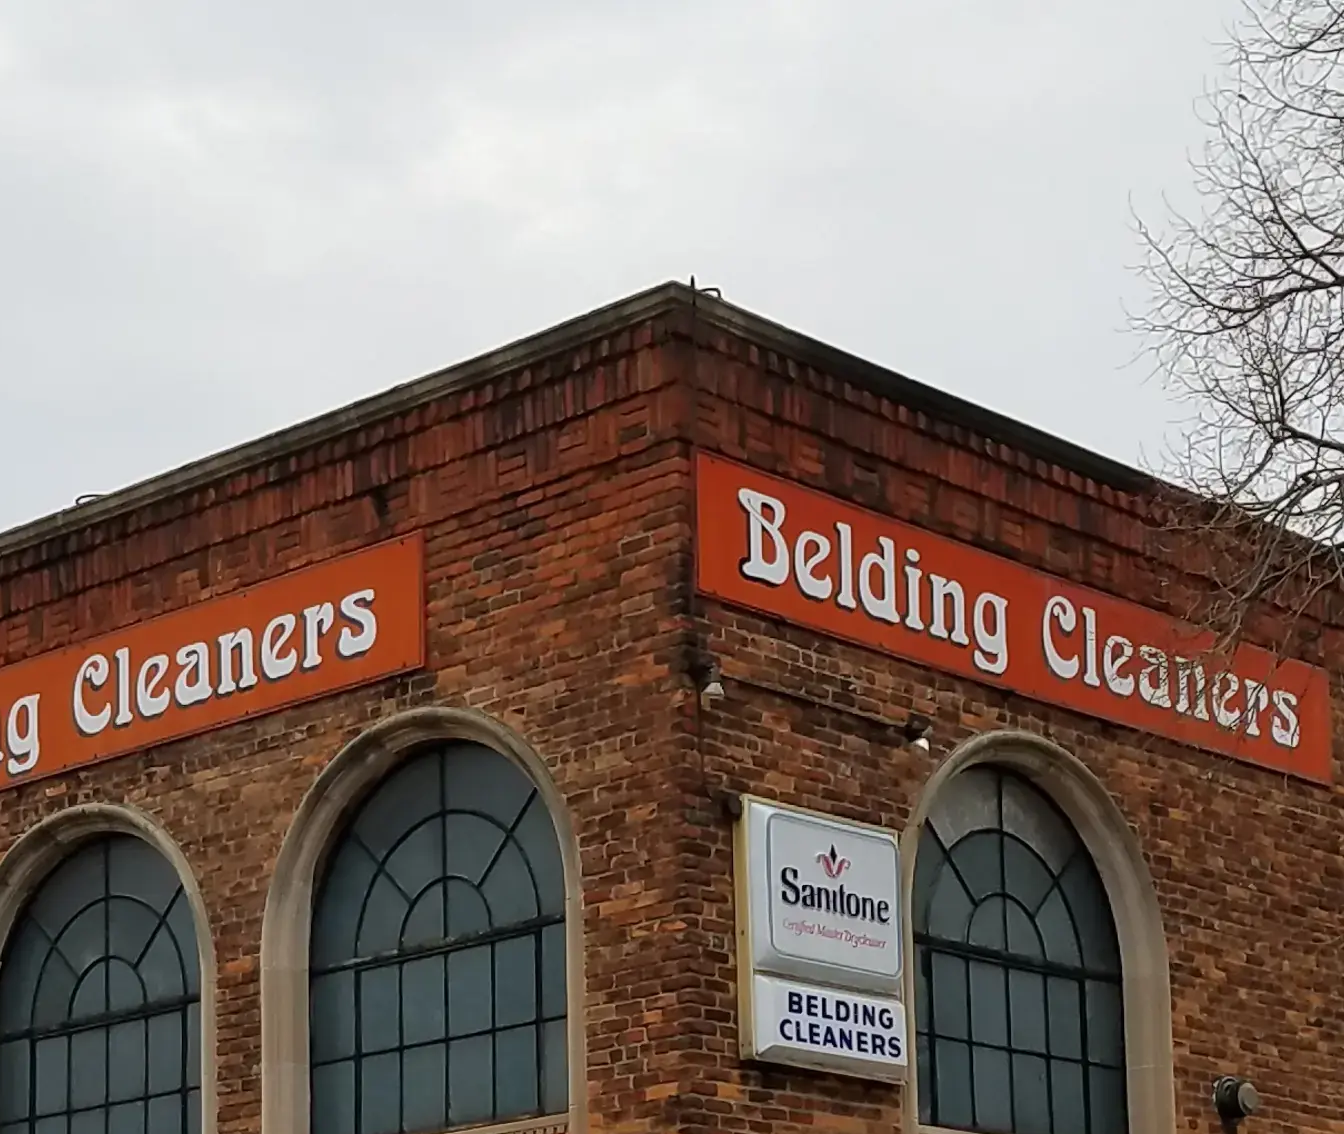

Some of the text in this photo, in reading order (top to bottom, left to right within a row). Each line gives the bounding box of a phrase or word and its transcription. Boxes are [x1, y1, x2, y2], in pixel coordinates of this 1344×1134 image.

[73, 589, 377, 734] Cleaners
[738, 487, 1299, 748] Belding Cleaners
[780, 1018, 902, 1058] CLEANERS
[788, 991, 894, 1030] BELDING
